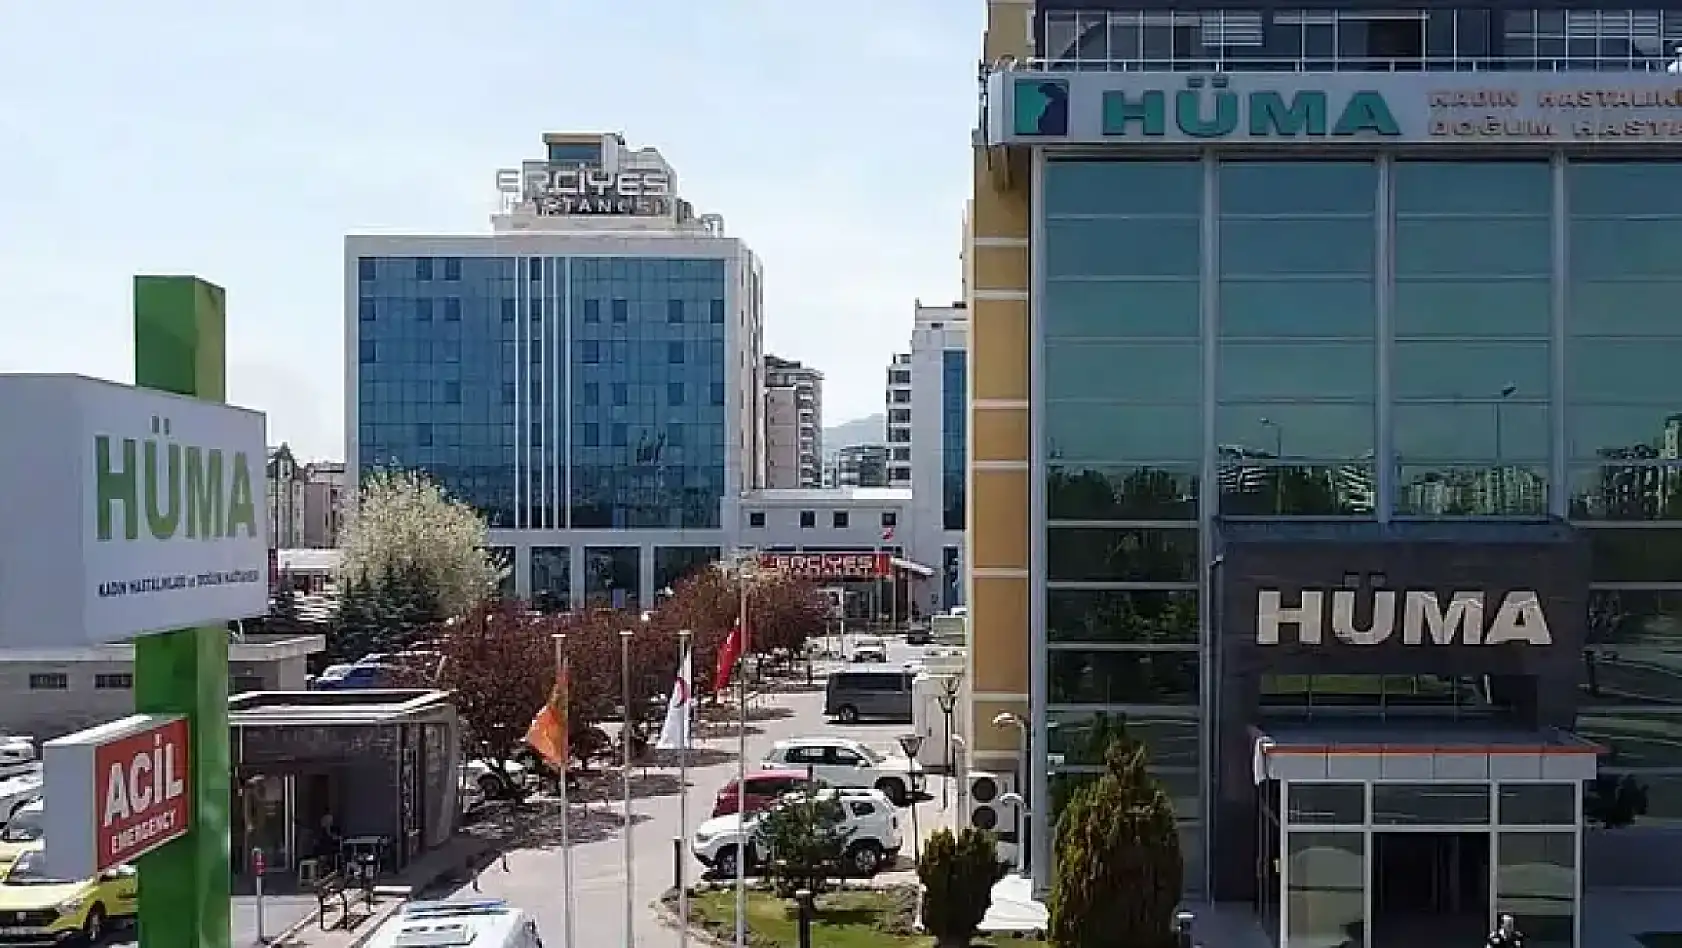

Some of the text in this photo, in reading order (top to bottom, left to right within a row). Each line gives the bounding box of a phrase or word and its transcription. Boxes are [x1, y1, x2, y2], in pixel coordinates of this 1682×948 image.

[1101, 75, 1402, 138] HÜMA
[1428, 115, 1557, 137] DOĞUM
[1429, 89, 1519, 108] KADIN
[496, 163, 670, 196] ERCİYES
[94, 415, 257, 541] HÜMA
[1255, 571, 1553, 645] HÜMA
[104, 733, 184, 827] ACİL
[111, 808, 176, 855] EMERGENCY
